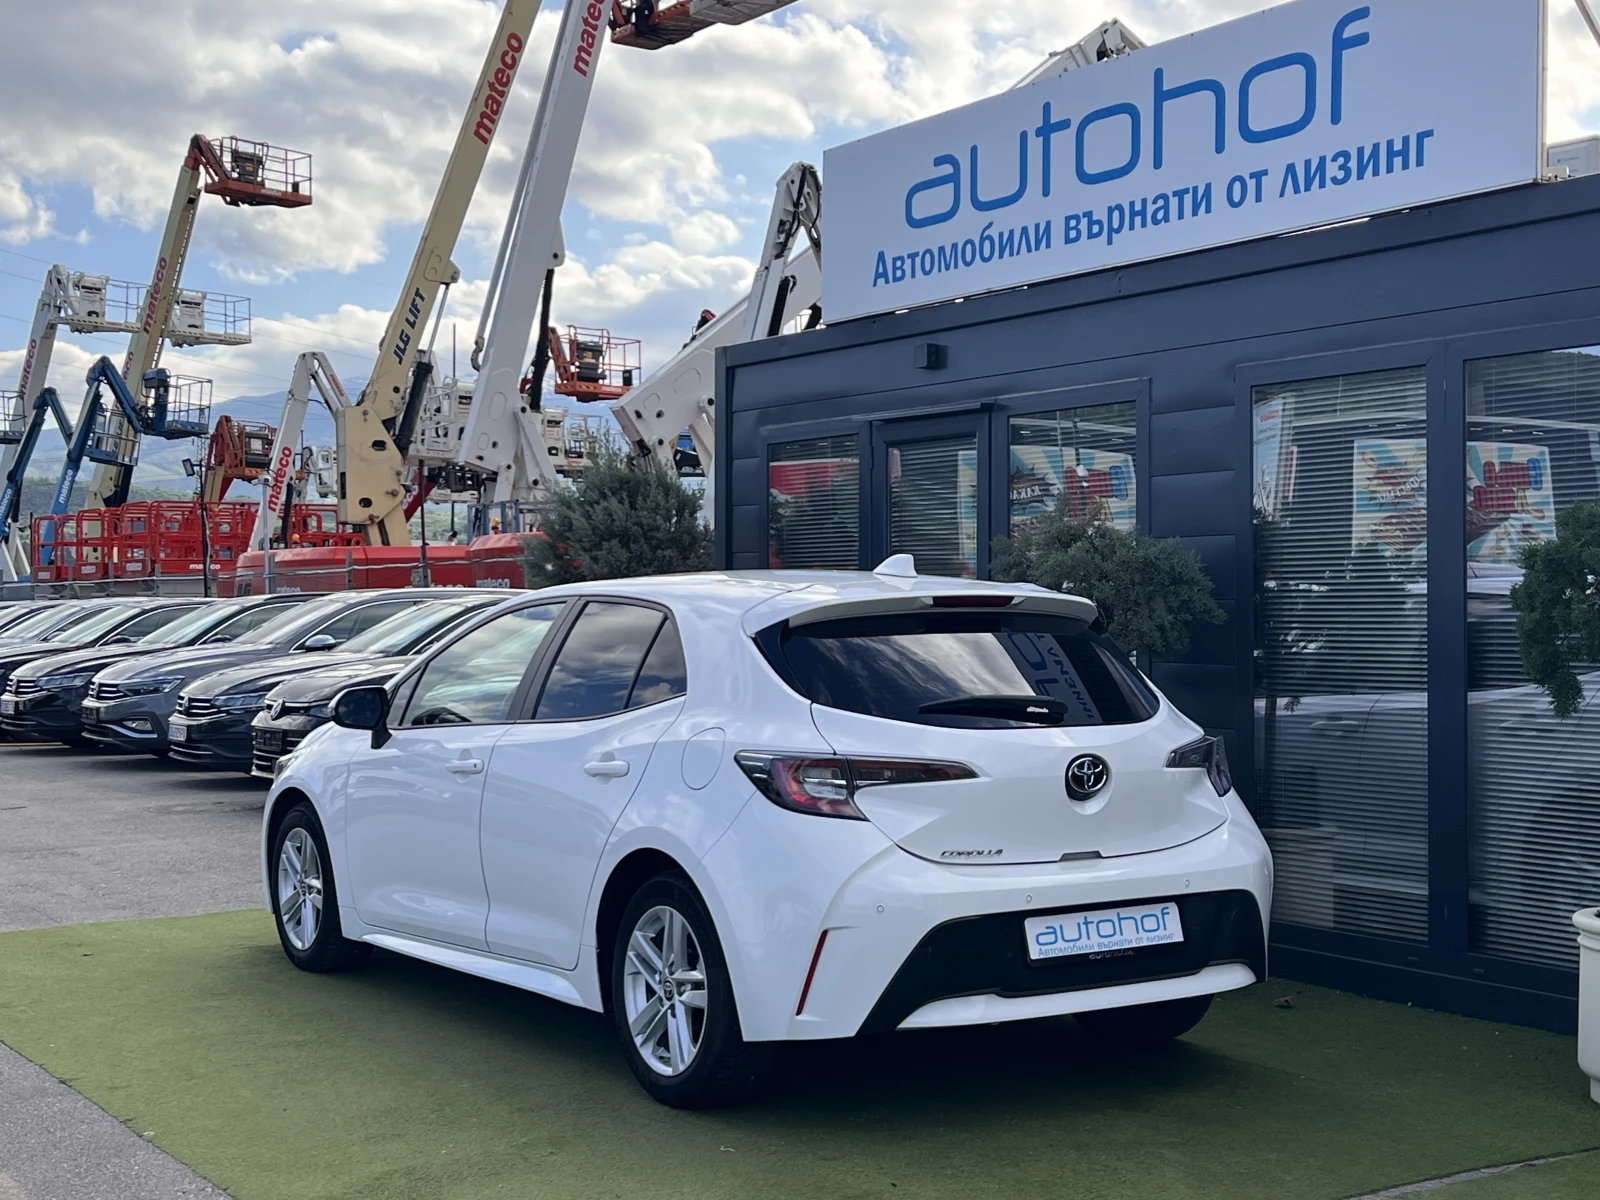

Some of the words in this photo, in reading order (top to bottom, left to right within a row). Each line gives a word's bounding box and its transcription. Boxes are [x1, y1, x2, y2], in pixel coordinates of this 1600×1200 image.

[573, 0, 605, 77] mate
[473, 32, 523, 145] mateco
[905, 6, 1370, 229] autohof
[872, 221, 1052, 287] Автомобили
[1064, 182, 1212, 245] върнати
[1226, 168, 1268, 208] от
[1279, 129, 1434, 198] лизинг
[143, 256, 167, 334] mateco
[393, 328, 411, 366] JLG
[405, 286, 425, 330] LIFT
[123, 351, 134, 380] eco
[58, 469, 73, 504] mateco
[267, 446, 292, 512] mateco
[401, 484, 419, 510] eco
[1035, 906, 1170, 946] autohof
[1038, 943, 1095, 957] Автомобили
[1097, 938, 1133, 950] върнати
[1135, 936, 1144, 946] от
[1146, 933, 1174, 944] лизинг
